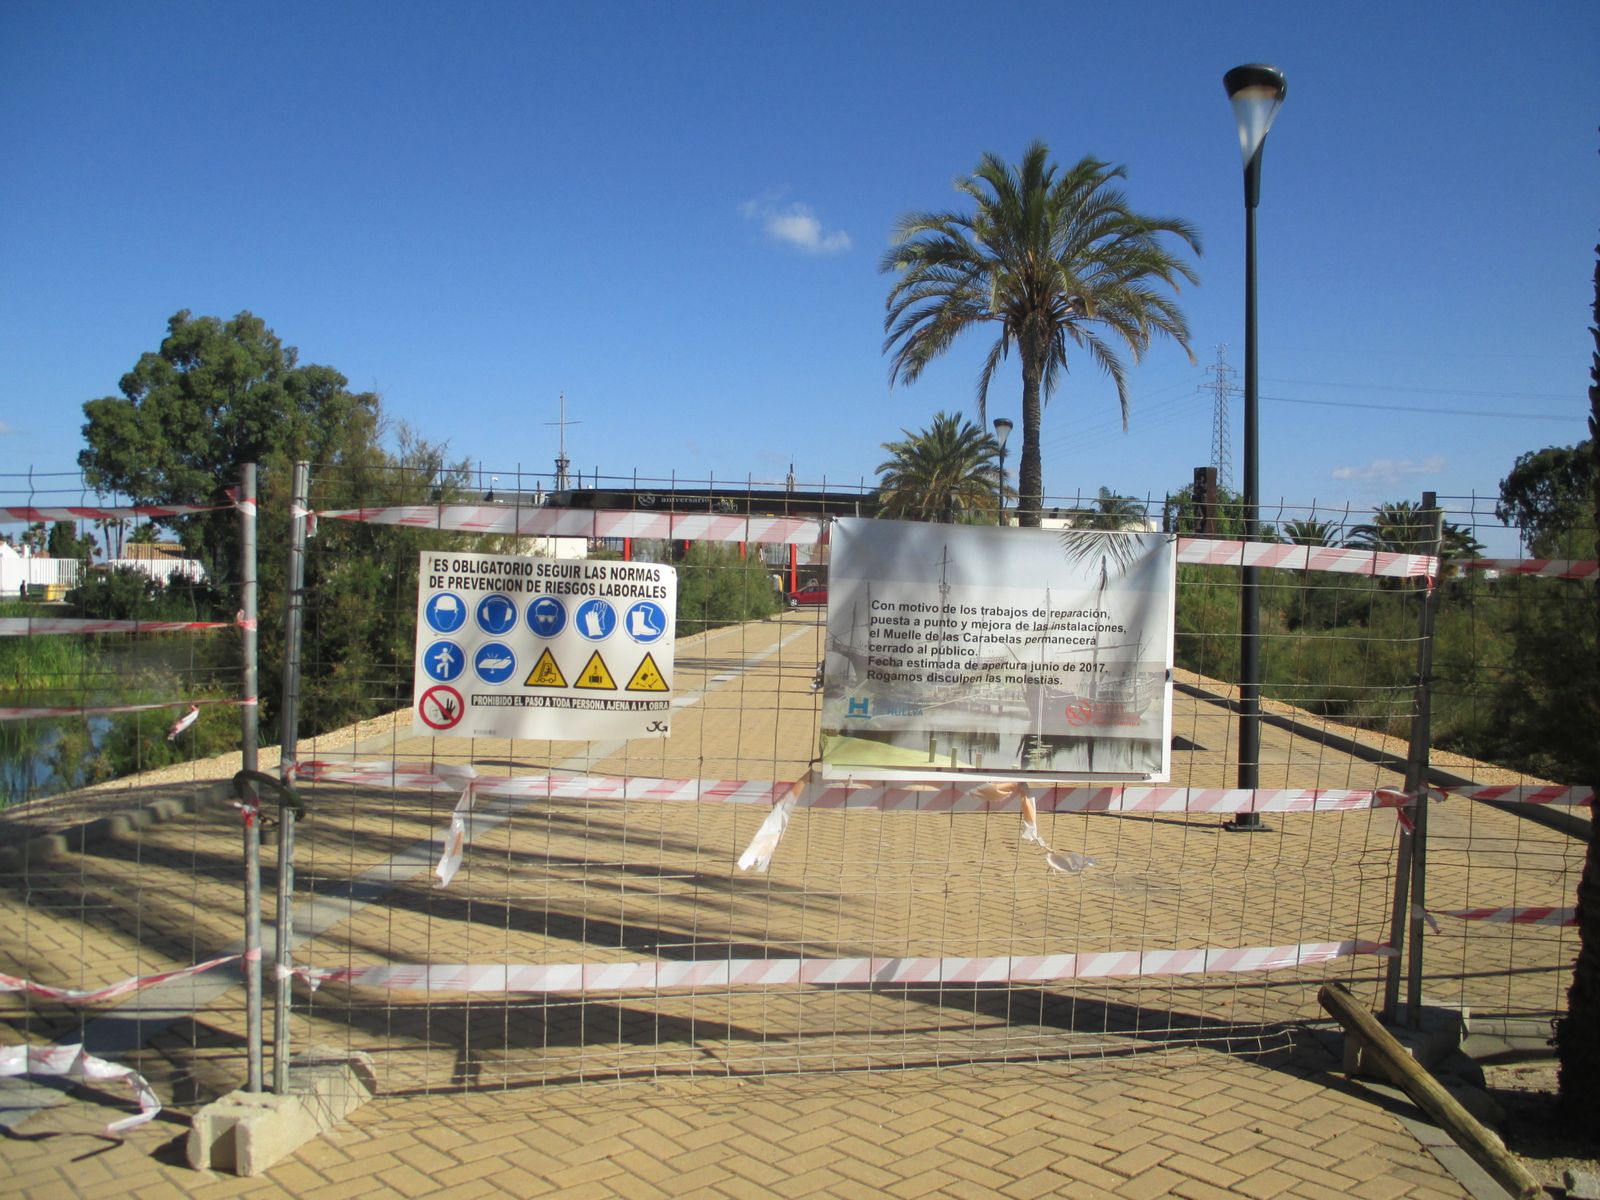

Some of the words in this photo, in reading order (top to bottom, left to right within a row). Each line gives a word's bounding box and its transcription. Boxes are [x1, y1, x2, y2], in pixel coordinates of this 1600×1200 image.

[434, 559, 448, 572] ES
[452, 560, 533, 576] OBLIGATORIO
[536, 564, 581, 579] SEGUIR
[584, 566, 606, 580] LAS
[610, 567, 660, 582] NORMAS
[429, 576, 444, 588] DE
[448, 576, 522, 592] PREVENCION
[526, 580, 541, 593] DE
[545, 581, 595, 596] RIESGOS
[599, 584, 667, 599] LABORALES
[872, 600, 895, 610] Con
[899, 602, 939, 613] motivo
[942, 604, 956, 614] de
[960, 605, 977, 615] los
[981, 606, 1028, 618] trabajos
[1032, 608, 1046, 617] de
[1050, 609, 1110, 620] reparación,
[870, 616, 910, 626] puesta
[924, 618, 957, 628] punto
[961, 621, 968, 630] y
[971, 620, 1011, 631] mejora
[1016, 621, 1029, 630] de
[1033, 622, 1048, 631] las
[1051, 622, 1126, 634] instalaciones,
[869, 628, 880, 638] el
[884, 628, 921, 640] Muelle
[925, 631, 939, 640] de
[942, 632, 959, 641] las
[963, 633, 1022, 644] Carabelas
[1024, 635, 1096, 646] permanecerá
[868, 643, 914, 654] cerrado
[917, 644, 927, 654] al
[931, 645, 978, 656] público.
[868, 656, 903, 667] Fecha
[907, 658, 960, 669] estimada
[964, 661, 978, 670] de
[982, 662, 1027, 671] apertura
[1030, 661, 1059, 672] junio
[1062, 662, 1076, 671] de
[1079, 662, 1108, 673] 2017.
[867, 670, 922, 682] Rogamos
[927, 673, 982, 684] disculpen
[985, 674, 1001, 683] las
[1005, 675, 1063, 685] molestias.
[473, 696, 512, 706] PROHIBIDO
[514, 696, 523, 706] EL
[524, 696, 544, 706] PASO
[545, 697, 550, 707] A
[552, 697, 570, 708] TODA
[572, 699, 605, 710] PERSONA
[606, 701, 630, 711] AJENA
[631, 702, 637, 711] A
[638, 702, 647, 711] LA
[649, 702, 668, 710] OBRA
